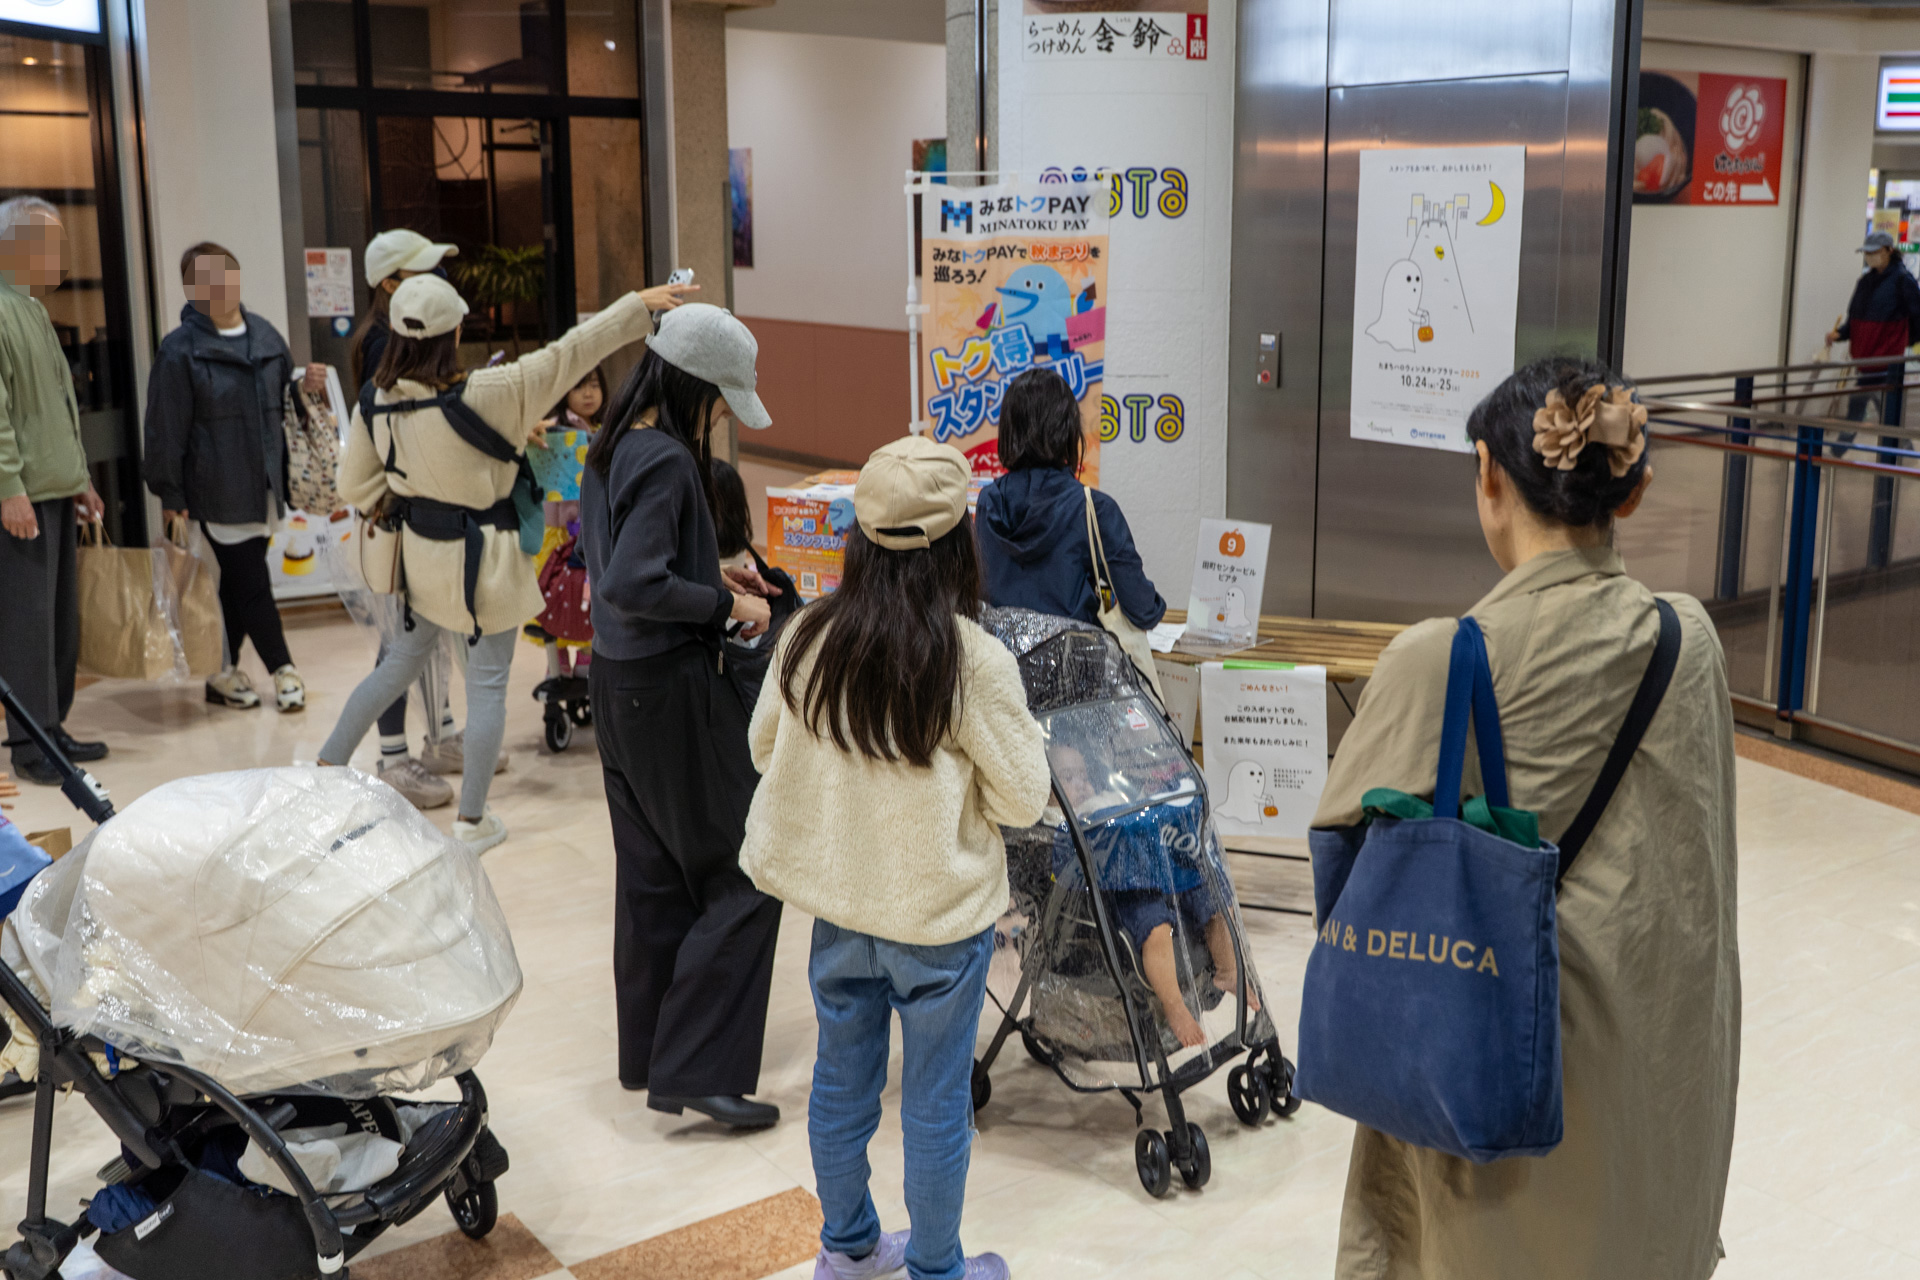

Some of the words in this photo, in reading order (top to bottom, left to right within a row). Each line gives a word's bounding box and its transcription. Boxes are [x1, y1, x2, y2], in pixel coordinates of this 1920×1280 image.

[1029, 19, 1086, 37] らーめん
[1189, 17, 1206, 58] 1階
[1028, 38, 1086, 55] つけめん
[1703, 181, 1738, 203] この先
[980, 218, 1058, 234] MINATOKU
[1063, 219, 1091, 232] PAY
[1460, 368, 1480, 379] 2025
[1227, 538, 1237, 552] 9
[1237, 705, 1295, 715] このスポットでの
[1342, 924, 1357, 953] &
[1366, 928, 1500, 977] DELUCA
